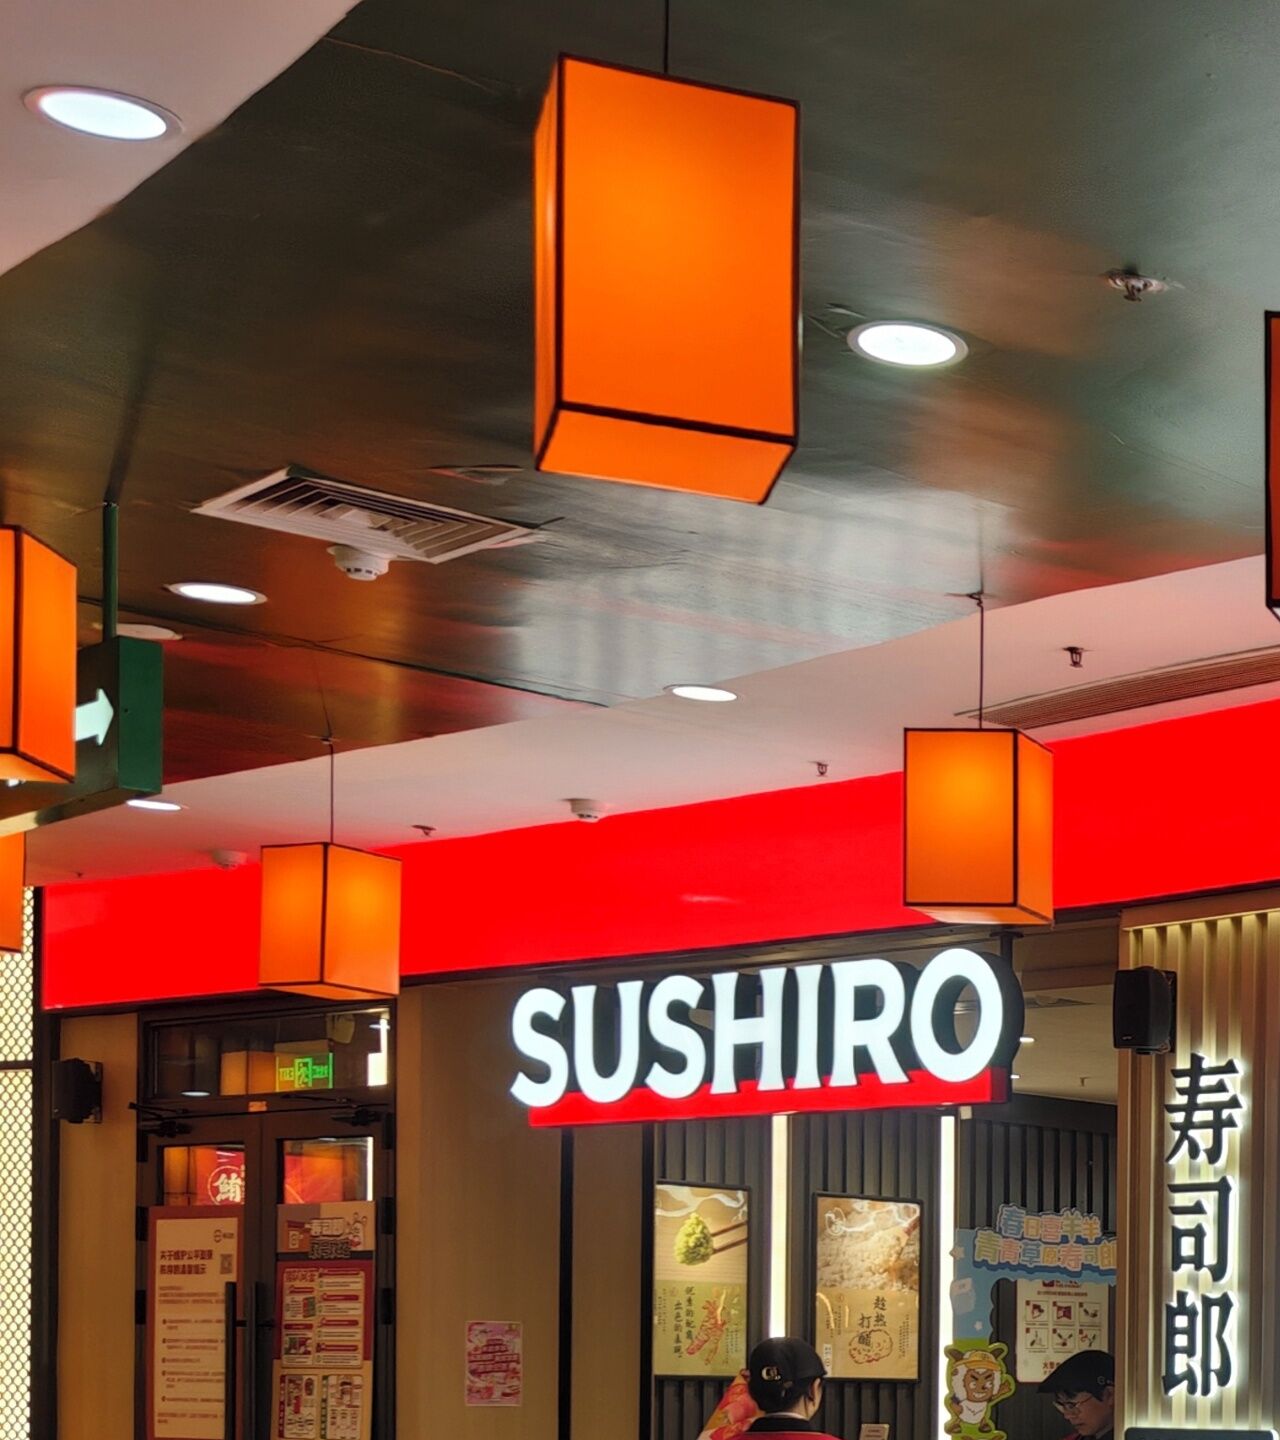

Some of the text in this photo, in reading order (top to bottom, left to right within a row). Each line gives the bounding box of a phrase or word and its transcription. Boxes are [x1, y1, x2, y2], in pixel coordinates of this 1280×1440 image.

[509, 947, 1004, 1108] SUSHIRO
[1161, 1052, 1243, 1399] 寿司郎
